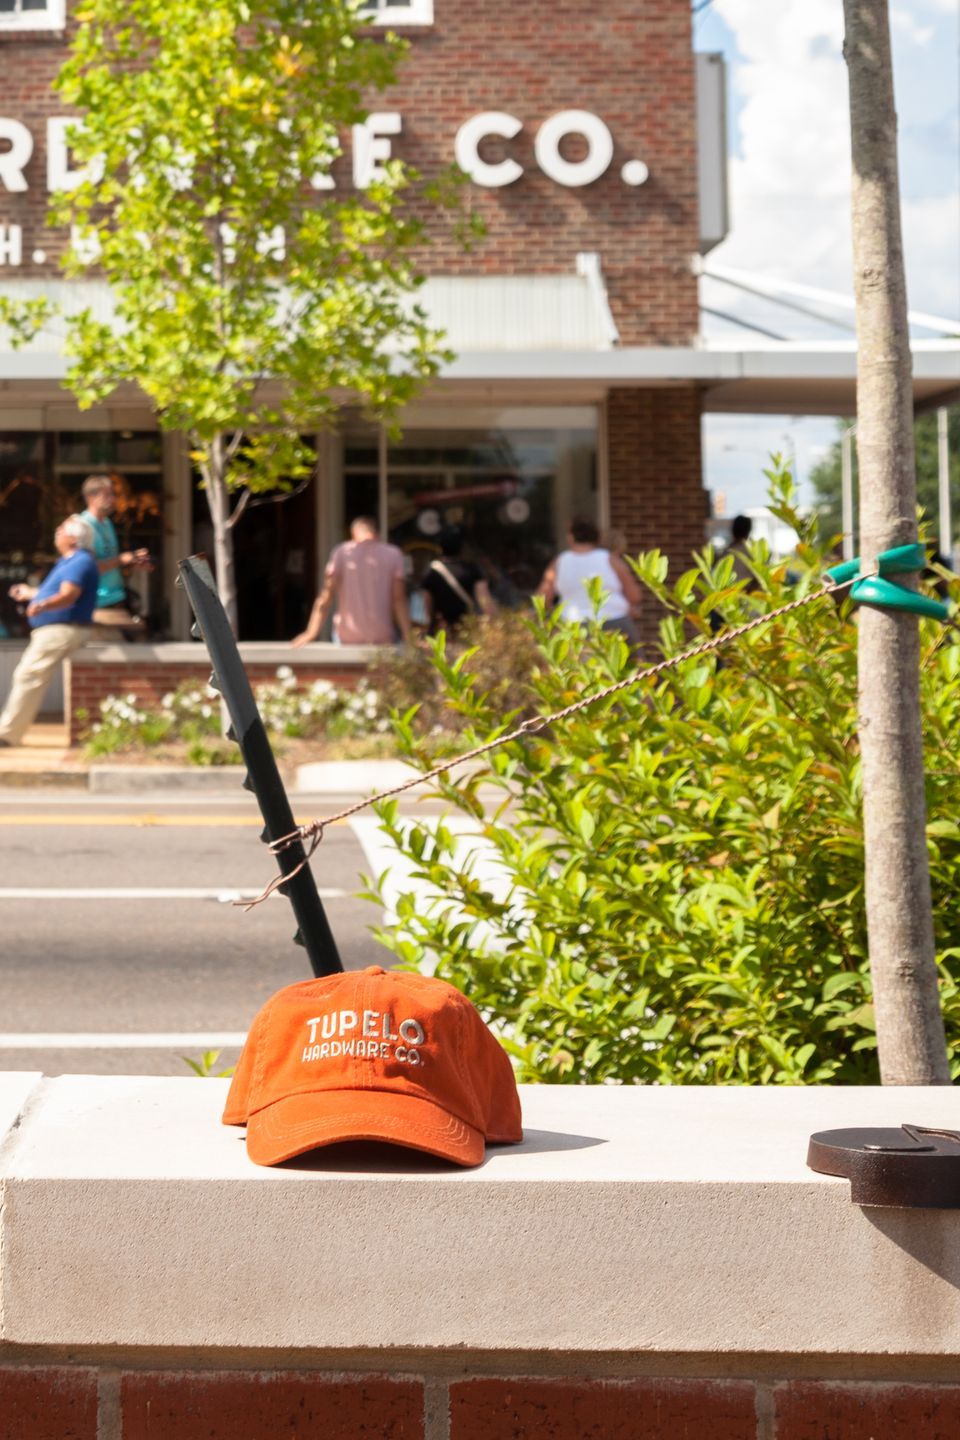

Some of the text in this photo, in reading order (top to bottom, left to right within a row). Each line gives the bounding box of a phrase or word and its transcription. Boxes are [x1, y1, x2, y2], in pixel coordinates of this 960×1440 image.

[455, 110, 648, 187] CO.
[306, 1010, 424, 1045] TUPELO
[302, 1040, 425, 1067] HARDWARE CO.
